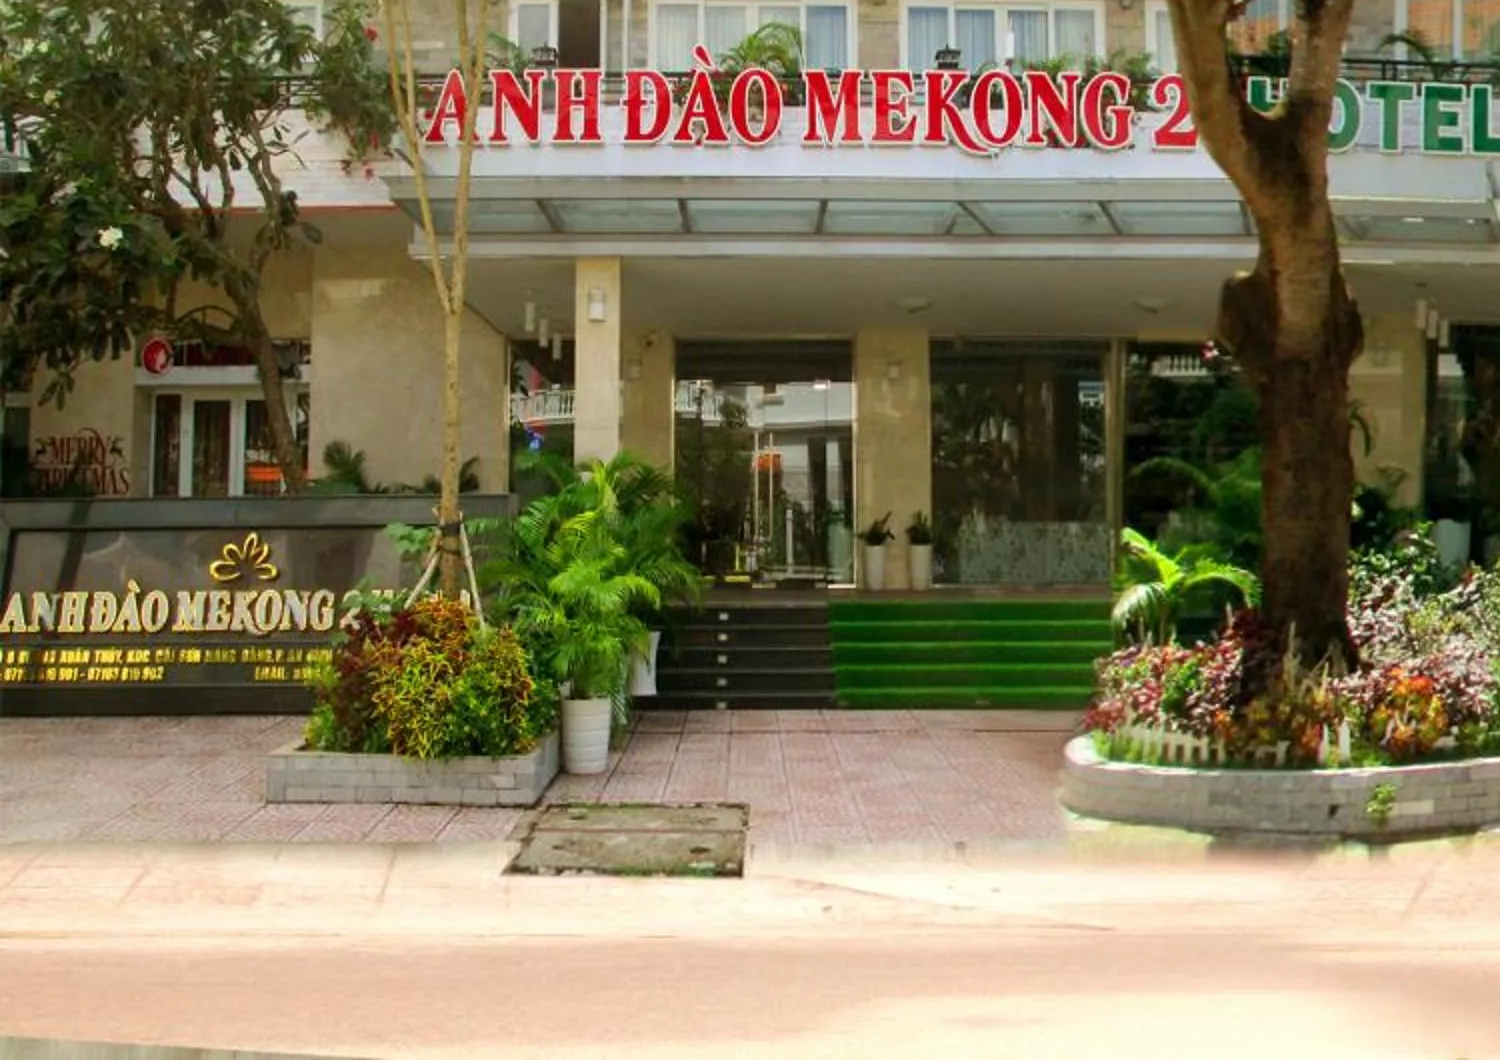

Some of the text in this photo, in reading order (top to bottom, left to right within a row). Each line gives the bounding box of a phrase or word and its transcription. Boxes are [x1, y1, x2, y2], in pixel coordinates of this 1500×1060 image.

[425, 69, 602, 142] ANH
[621, 45, 783, 143] ĐÀO
[803, 70, 1134, 154] MEKONG
[1152, 73, 1199, 152] 2
[0, 591, 88, 632] ANH
[89, 579, 169, 632] ĐÀO
[172, 590, 335, 635] MEKONG
